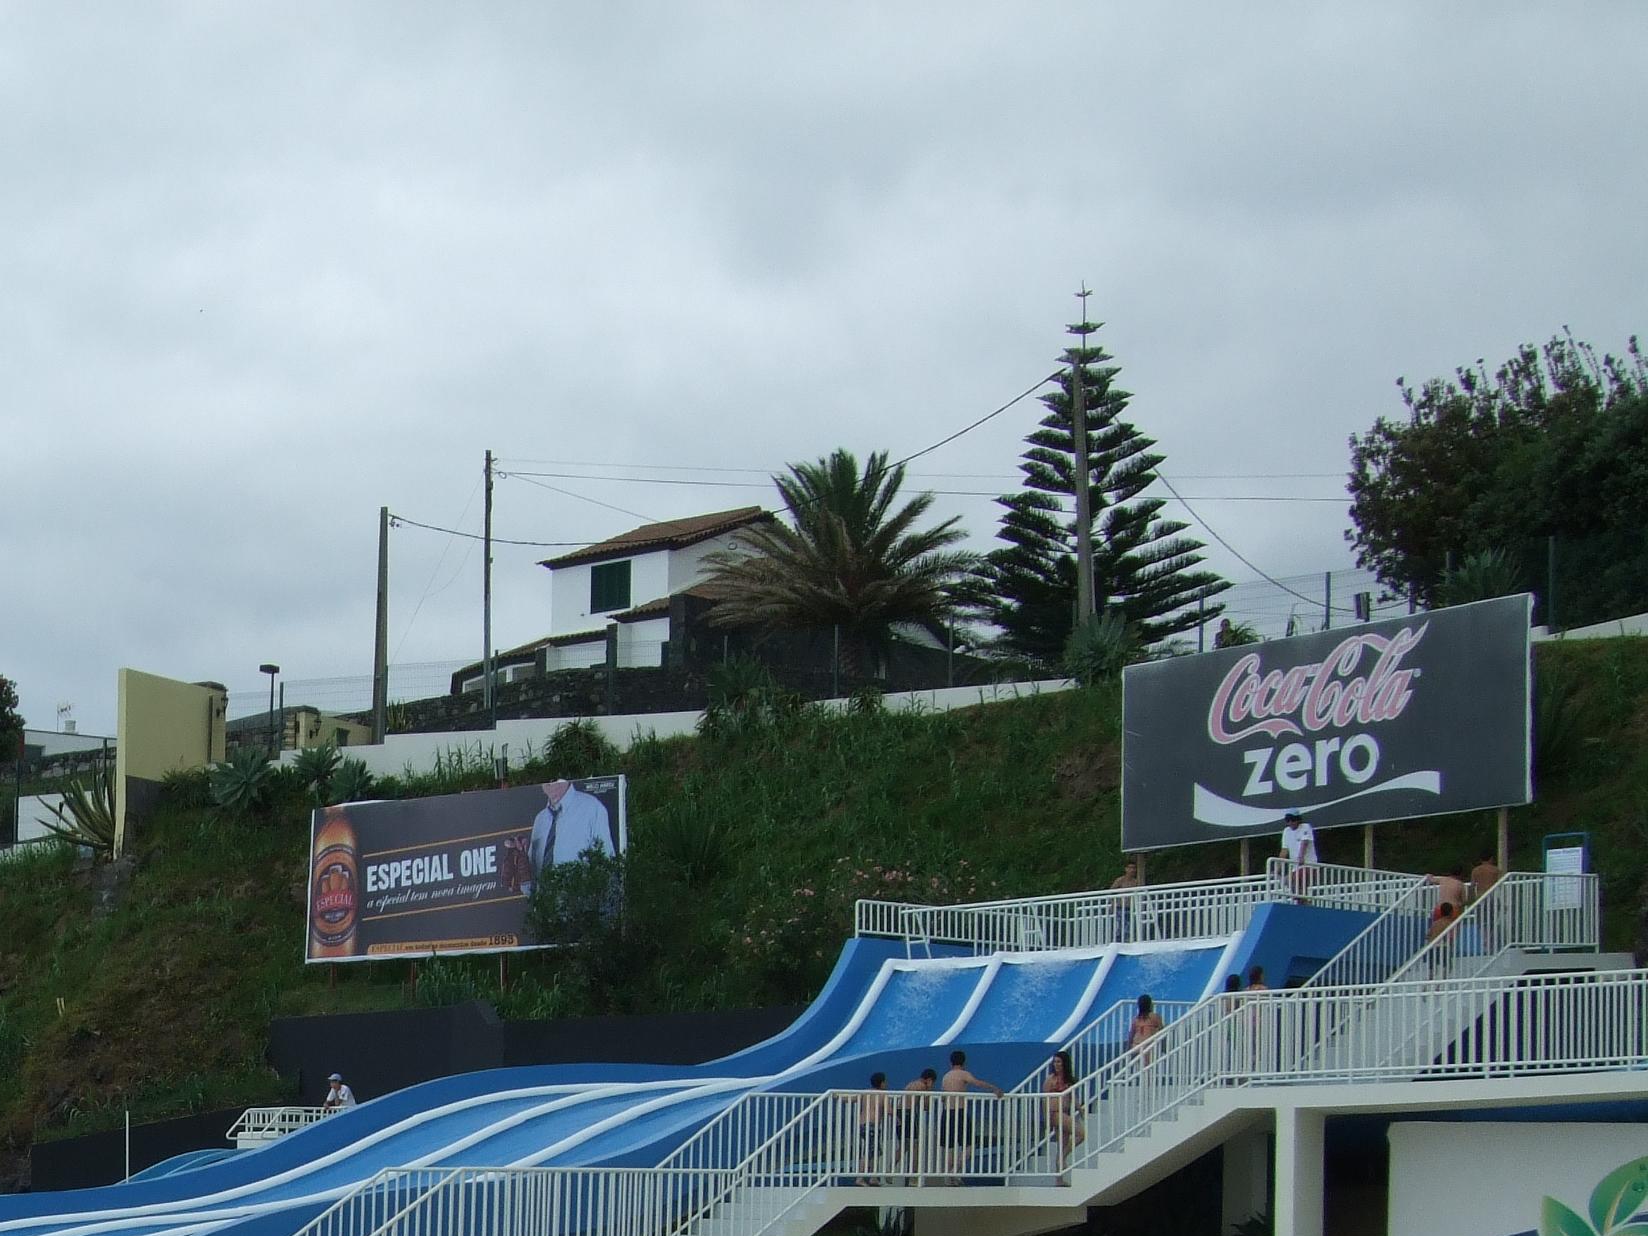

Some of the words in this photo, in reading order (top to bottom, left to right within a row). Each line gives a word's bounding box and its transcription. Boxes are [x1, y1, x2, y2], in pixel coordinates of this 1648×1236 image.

[1208, 620, 1429, 745] Coca-Cola
[1241, 732, 1380, 797] zero
[366, 853, 454, 893] ESPECIAL
[459, 845, 498, 878] ONE
[316, 893, 353, 912] ESPECIAL
[366, 900, 373, 910] a
[431, 887, 455, 899] nova
[456, 881, 498, 899] imagem
